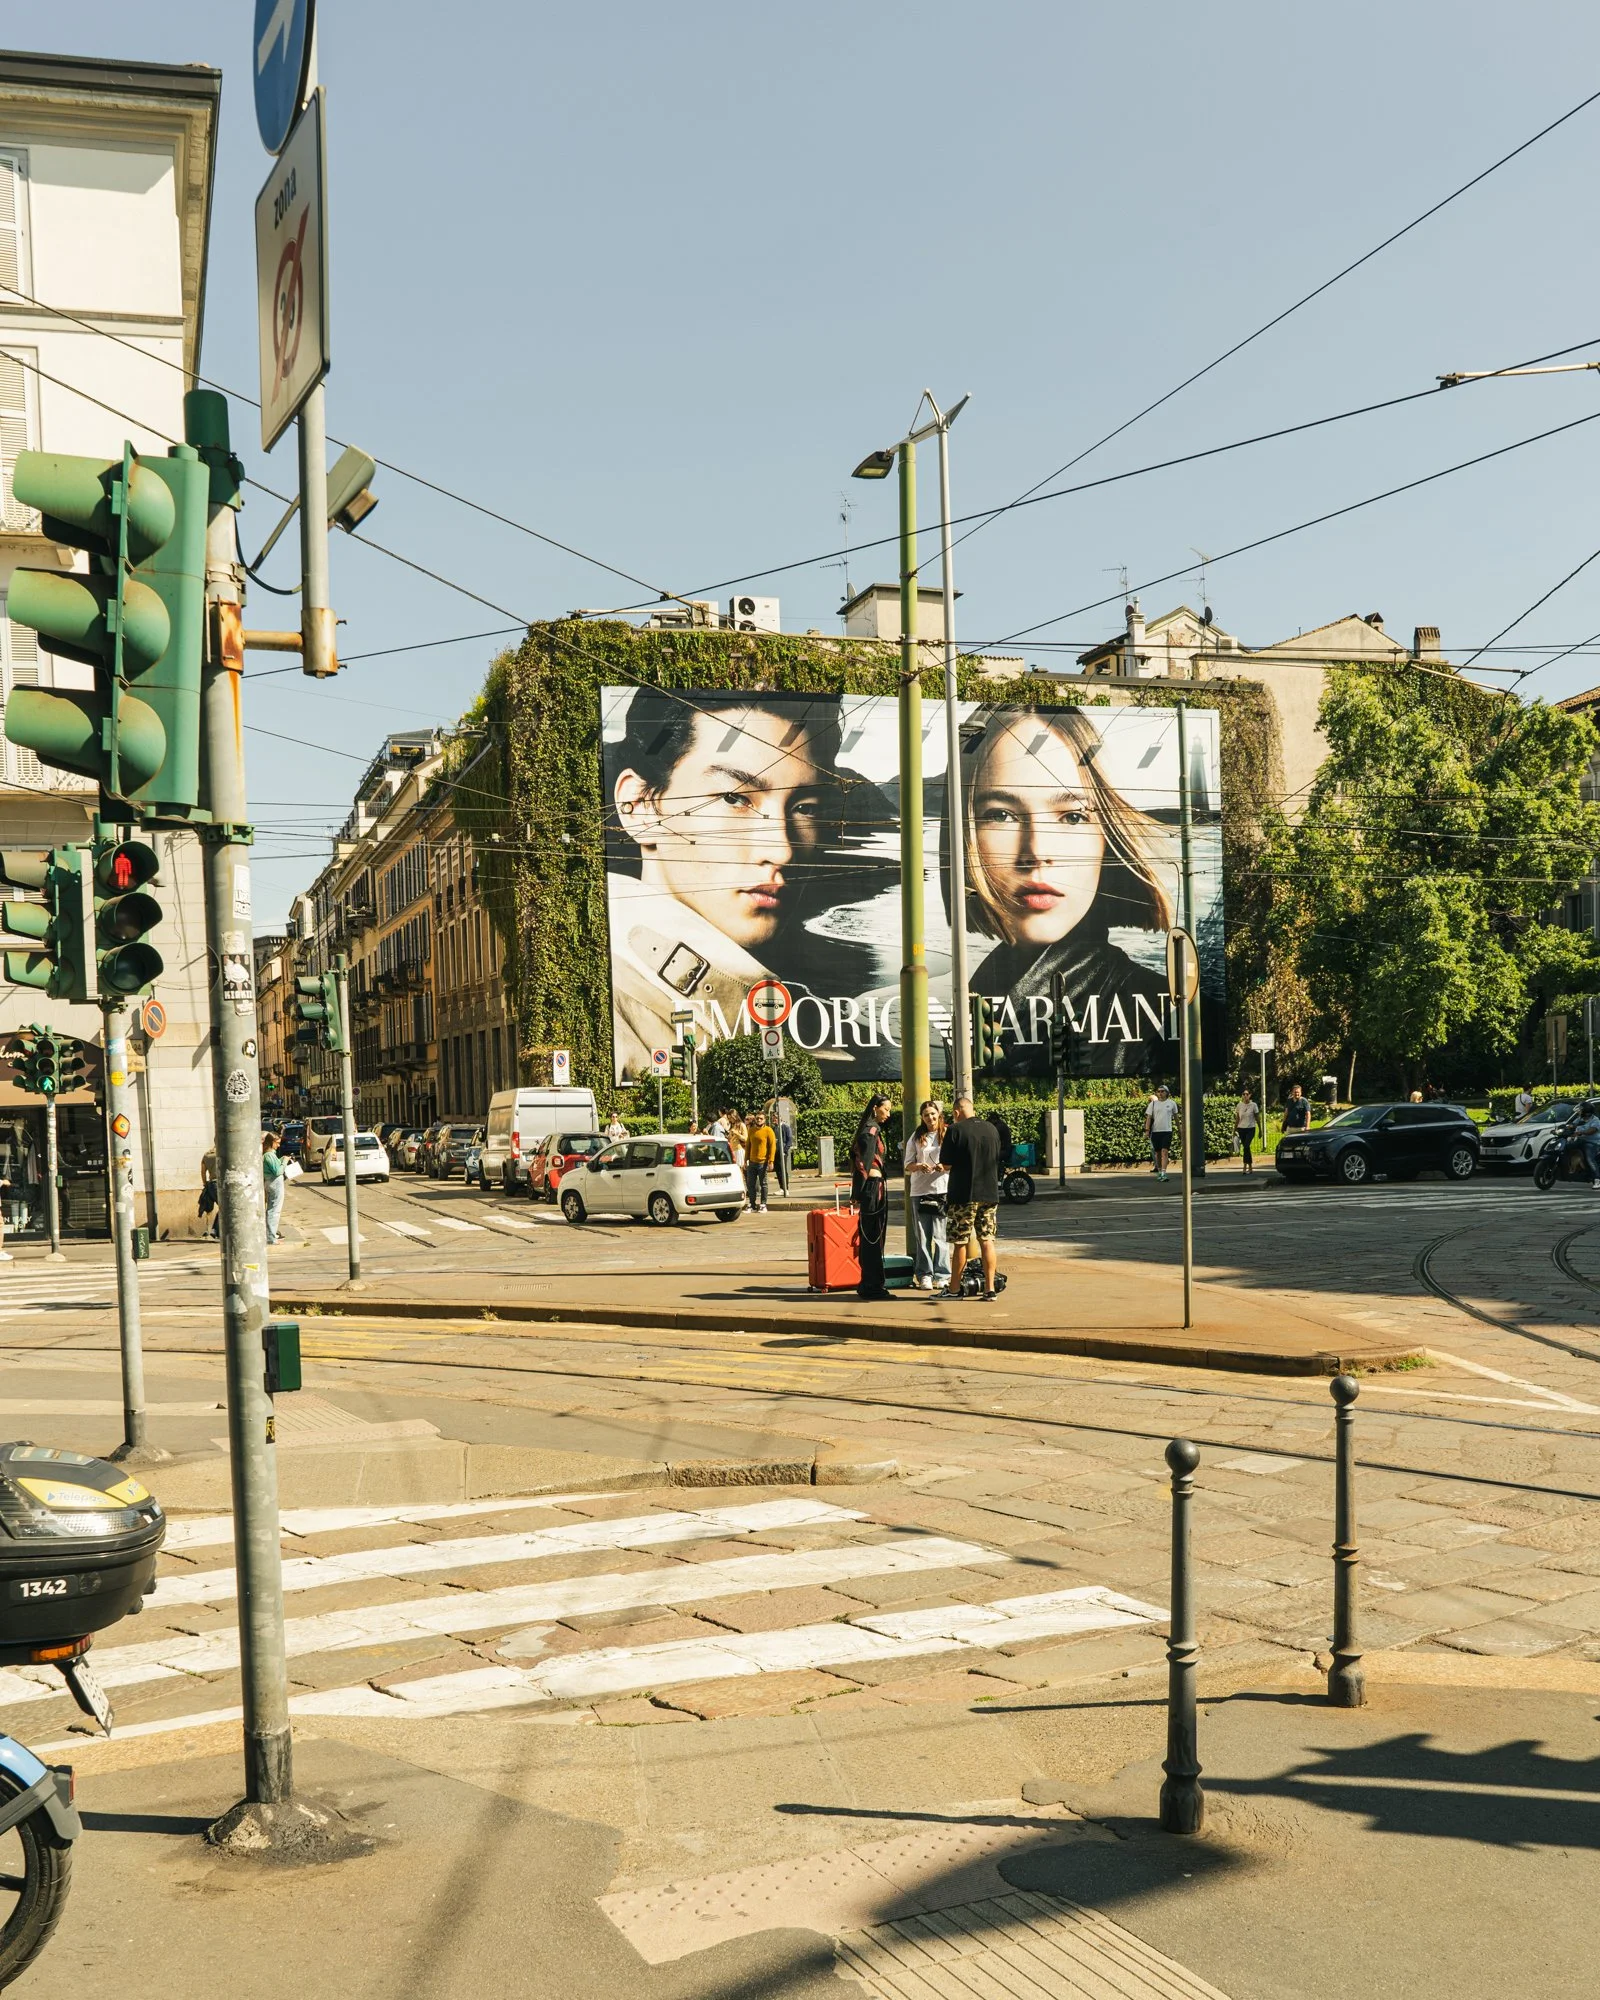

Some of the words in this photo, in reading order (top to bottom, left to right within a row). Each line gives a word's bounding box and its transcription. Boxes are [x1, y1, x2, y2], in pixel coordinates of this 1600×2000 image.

[273, 167, 297, 231] zona
[671, 996, 902, 1052] EMORI
[994, 992, 1181, 1046] ARMANI
[20, 1579, 67, 1598] 1342
